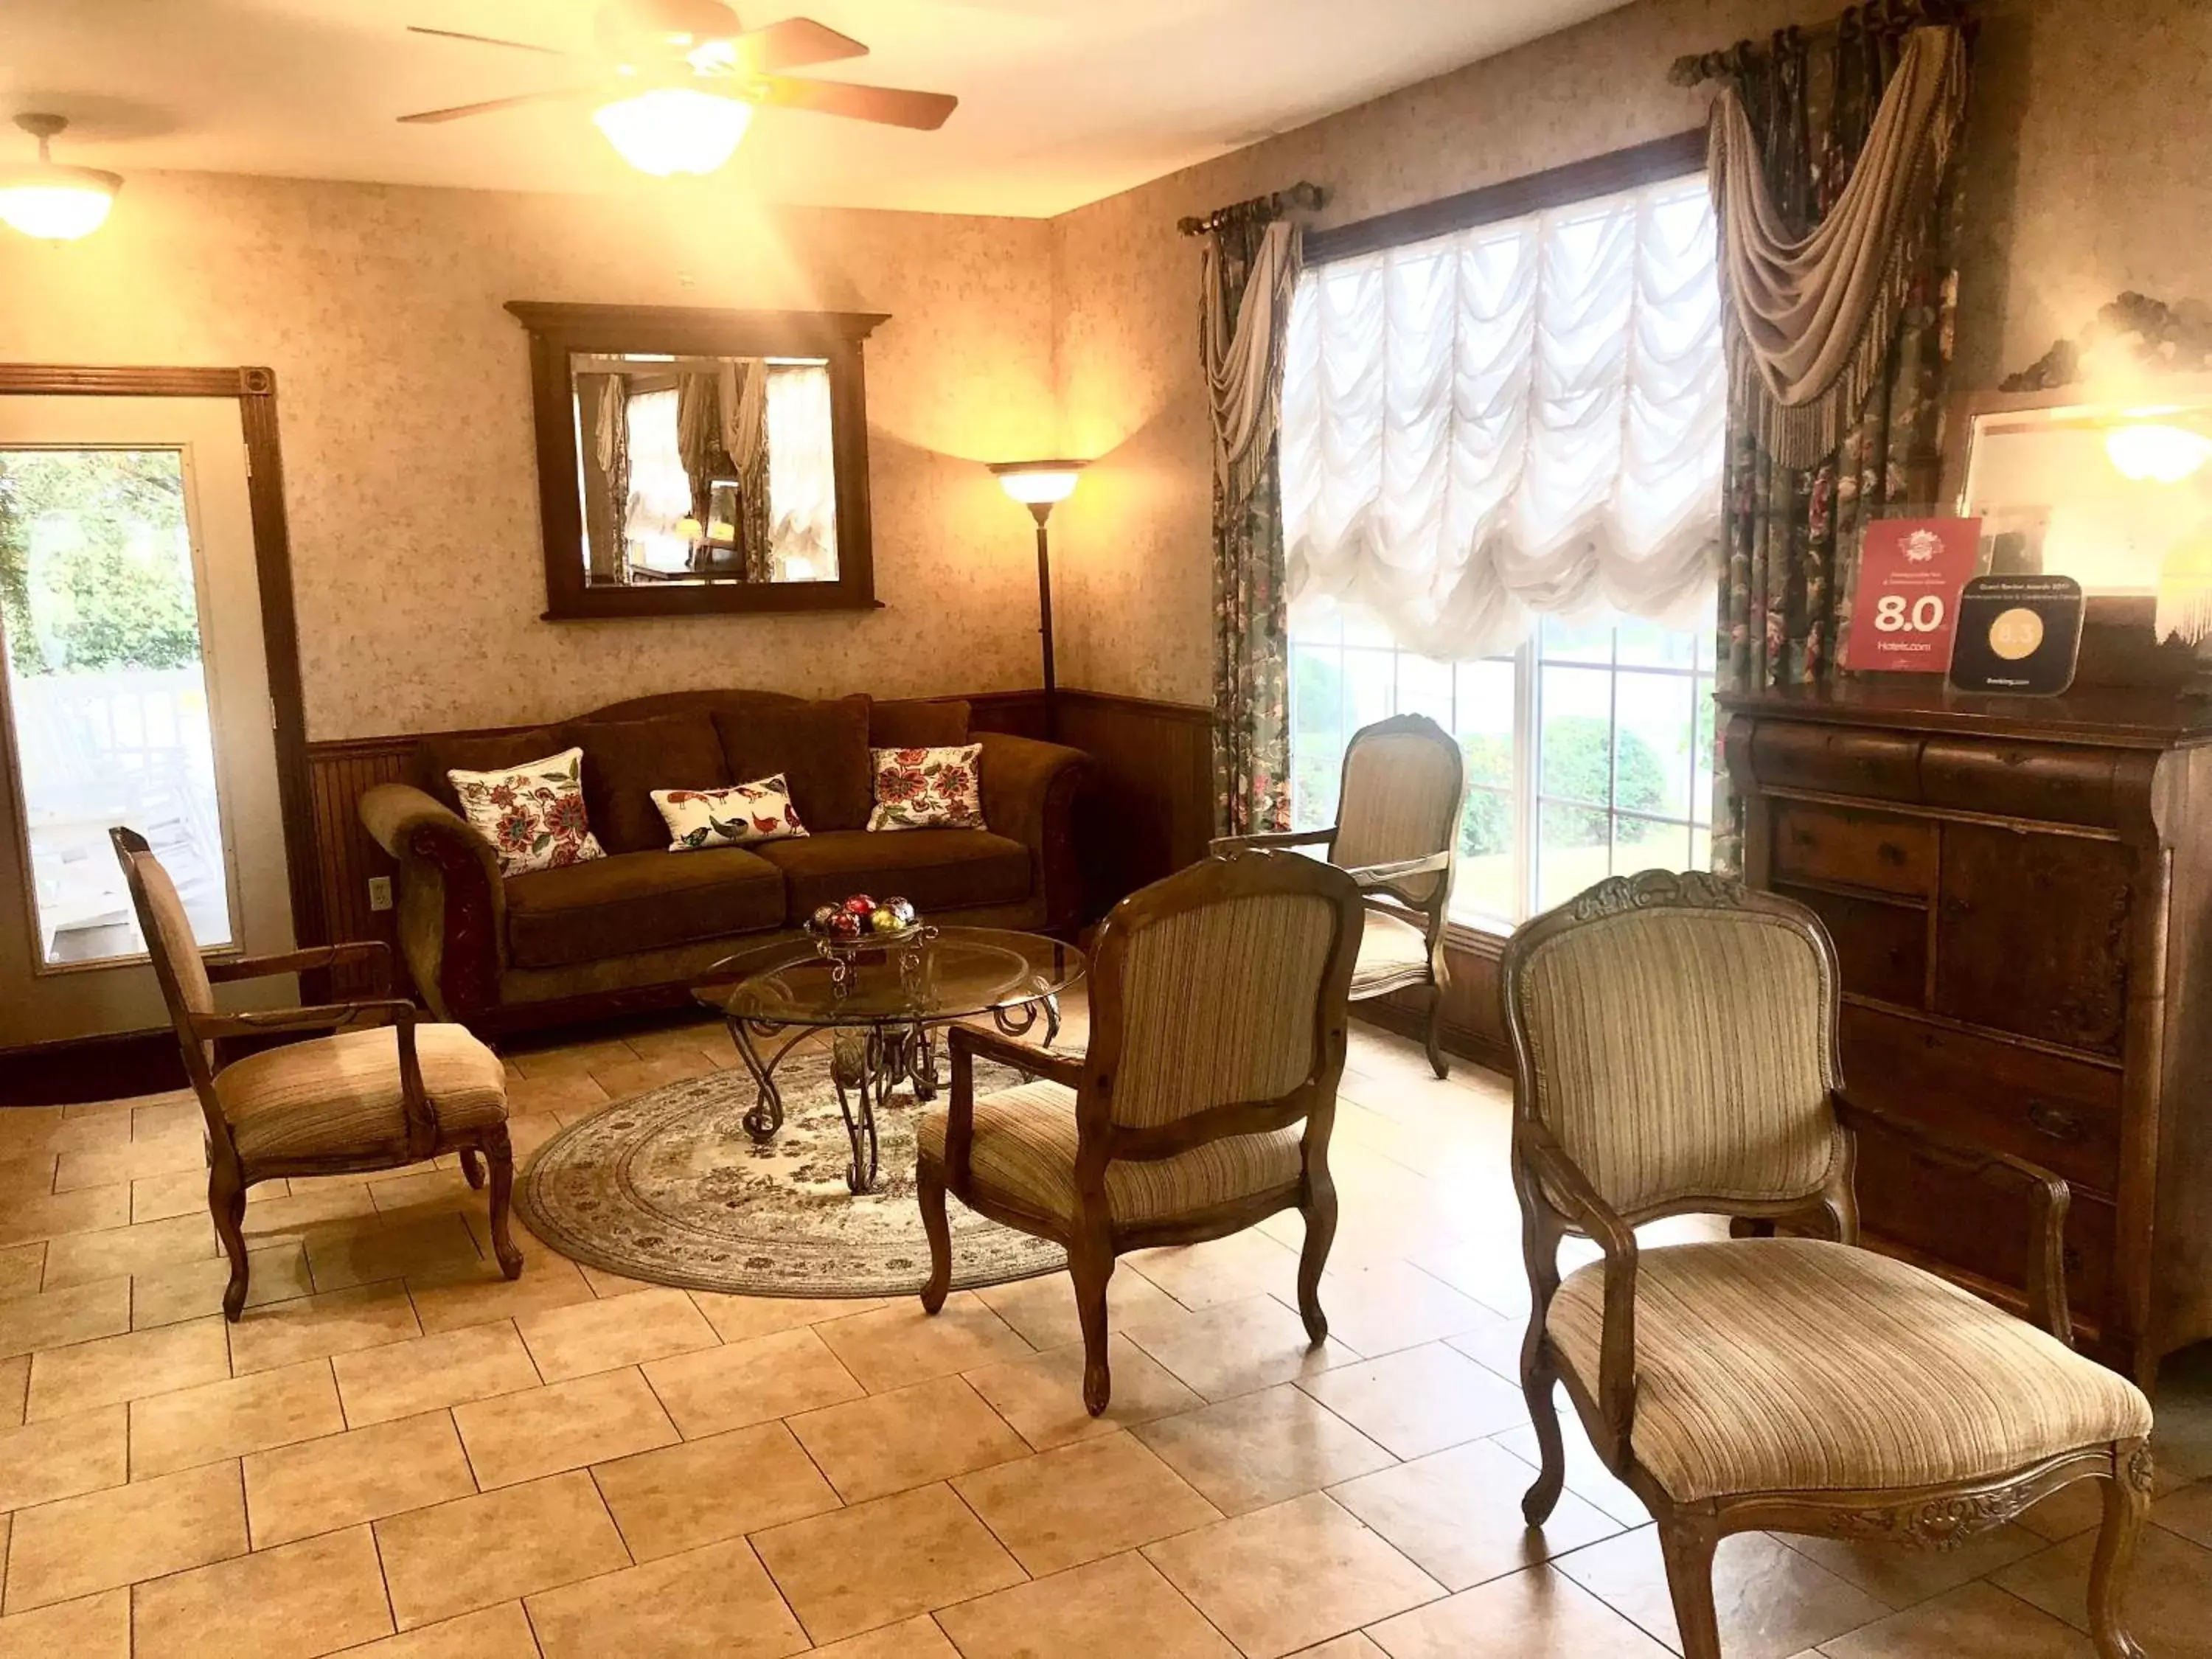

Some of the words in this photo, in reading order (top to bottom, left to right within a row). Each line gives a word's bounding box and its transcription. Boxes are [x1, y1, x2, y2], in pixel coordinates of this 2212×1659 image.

[1875, 595, 1944, 633] 8.0
[1997, 622, 2035, 644] 8.3
[1877, 640, 1932, 653] Hotels.com
